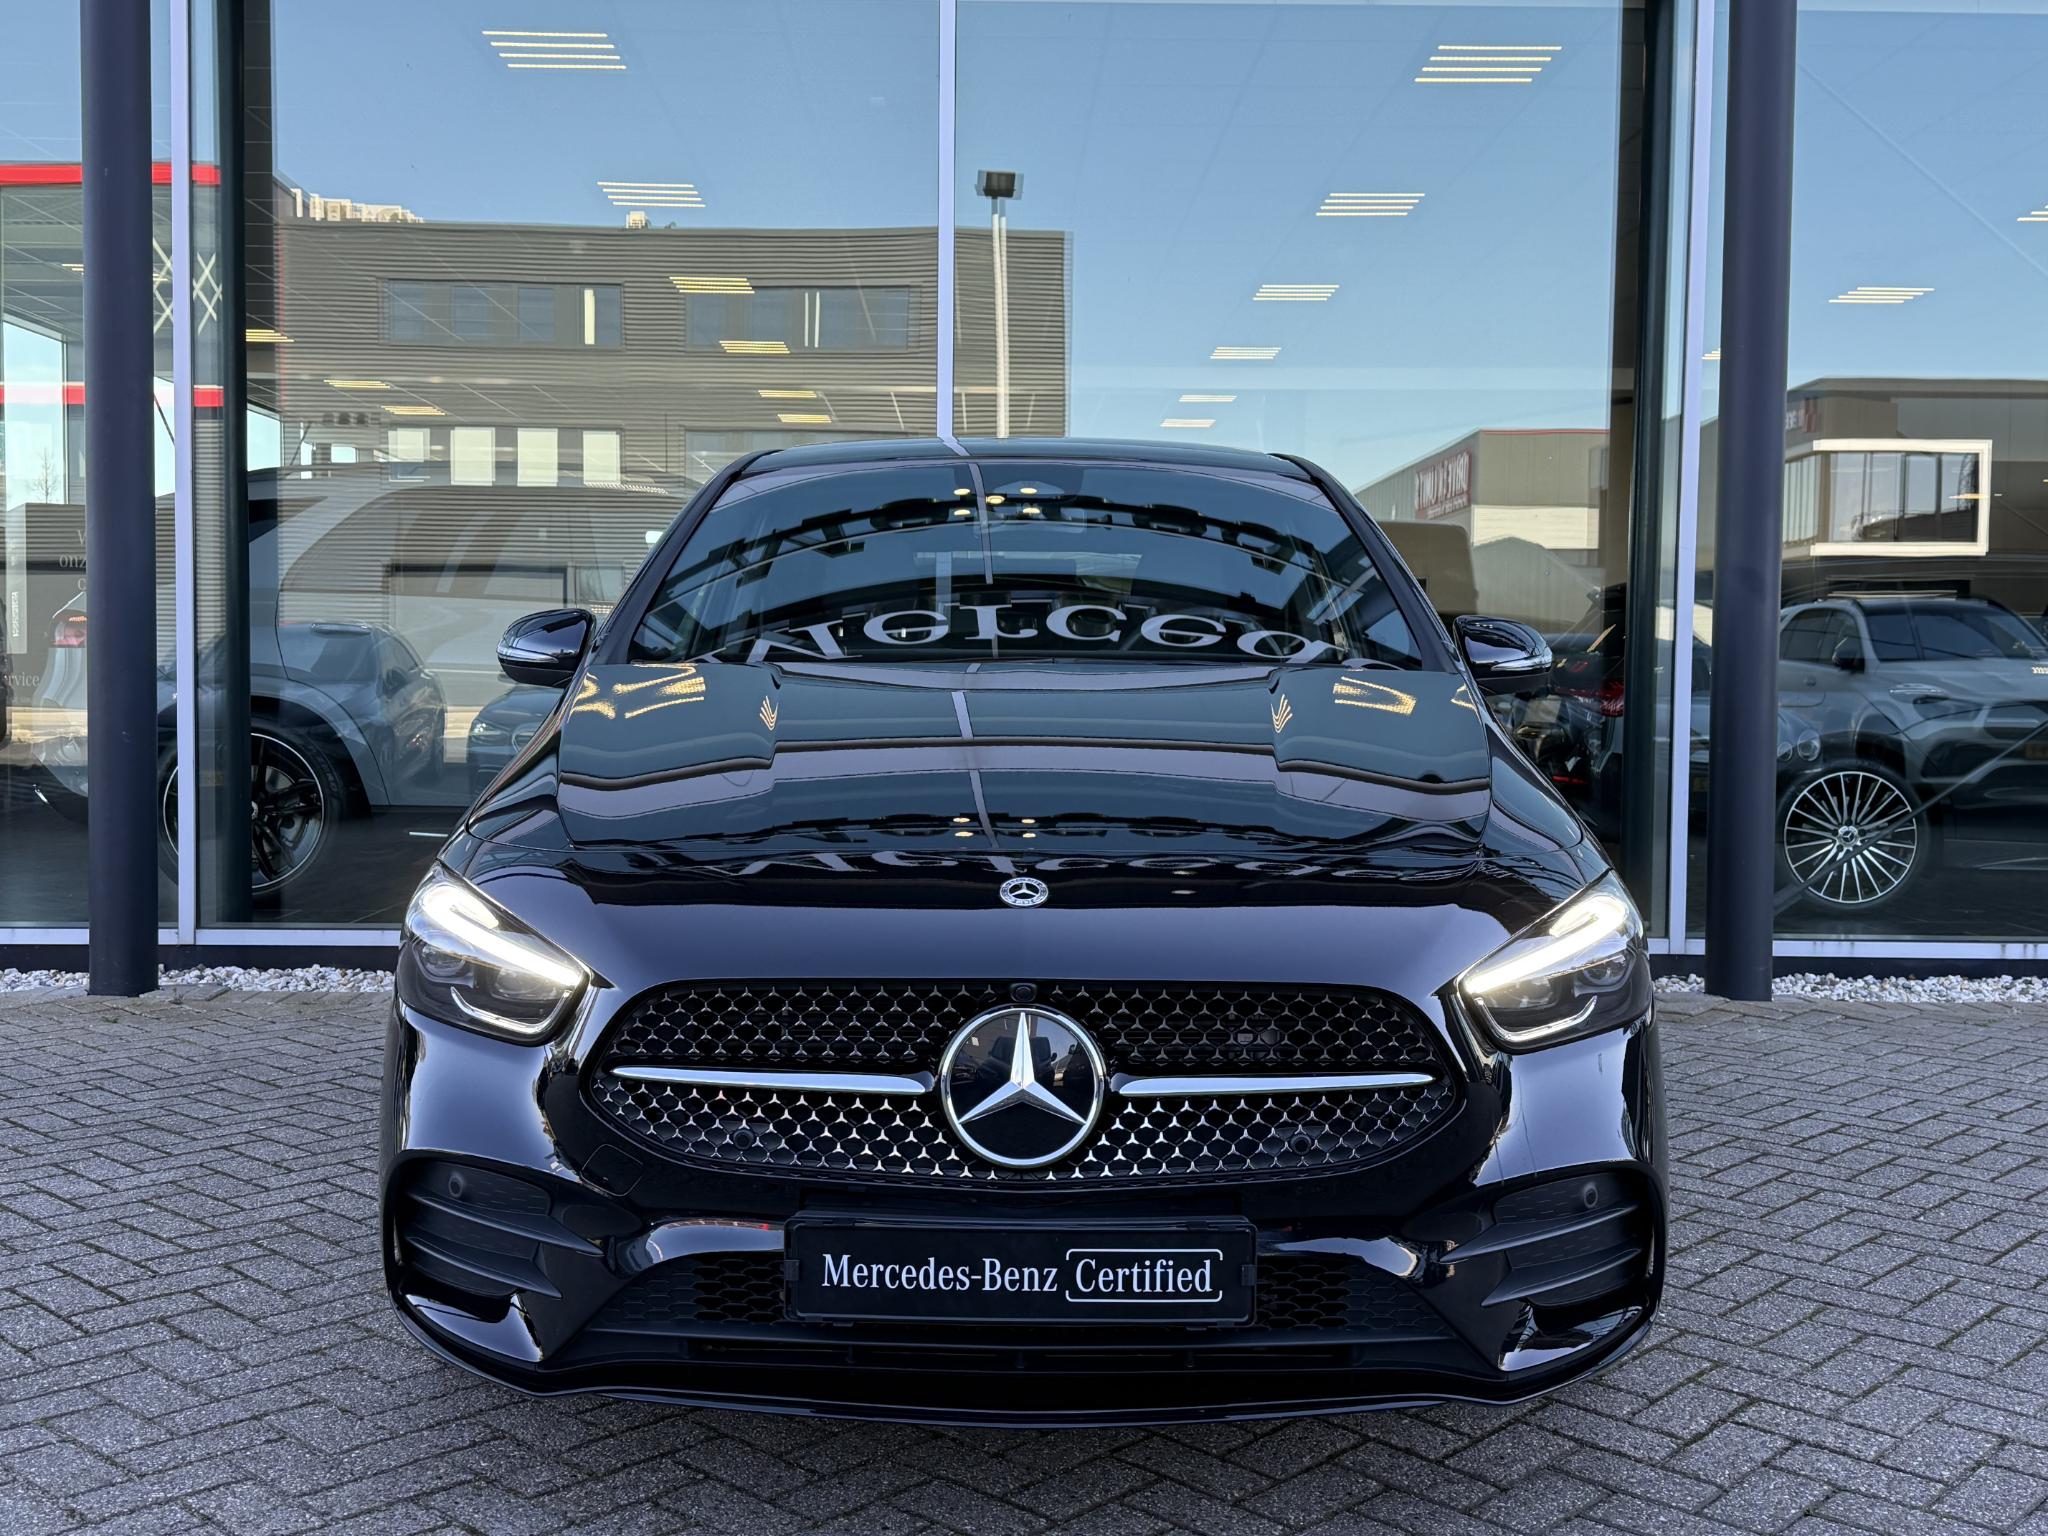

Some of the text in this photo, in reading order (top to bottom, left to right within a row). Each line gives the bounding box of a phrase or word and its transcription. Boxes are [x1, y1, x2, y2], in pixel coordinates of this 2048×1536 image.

[59, 553, 87, 568] onz
[821, 1253, 1213, 1293] Mercedes-Benz Certified
